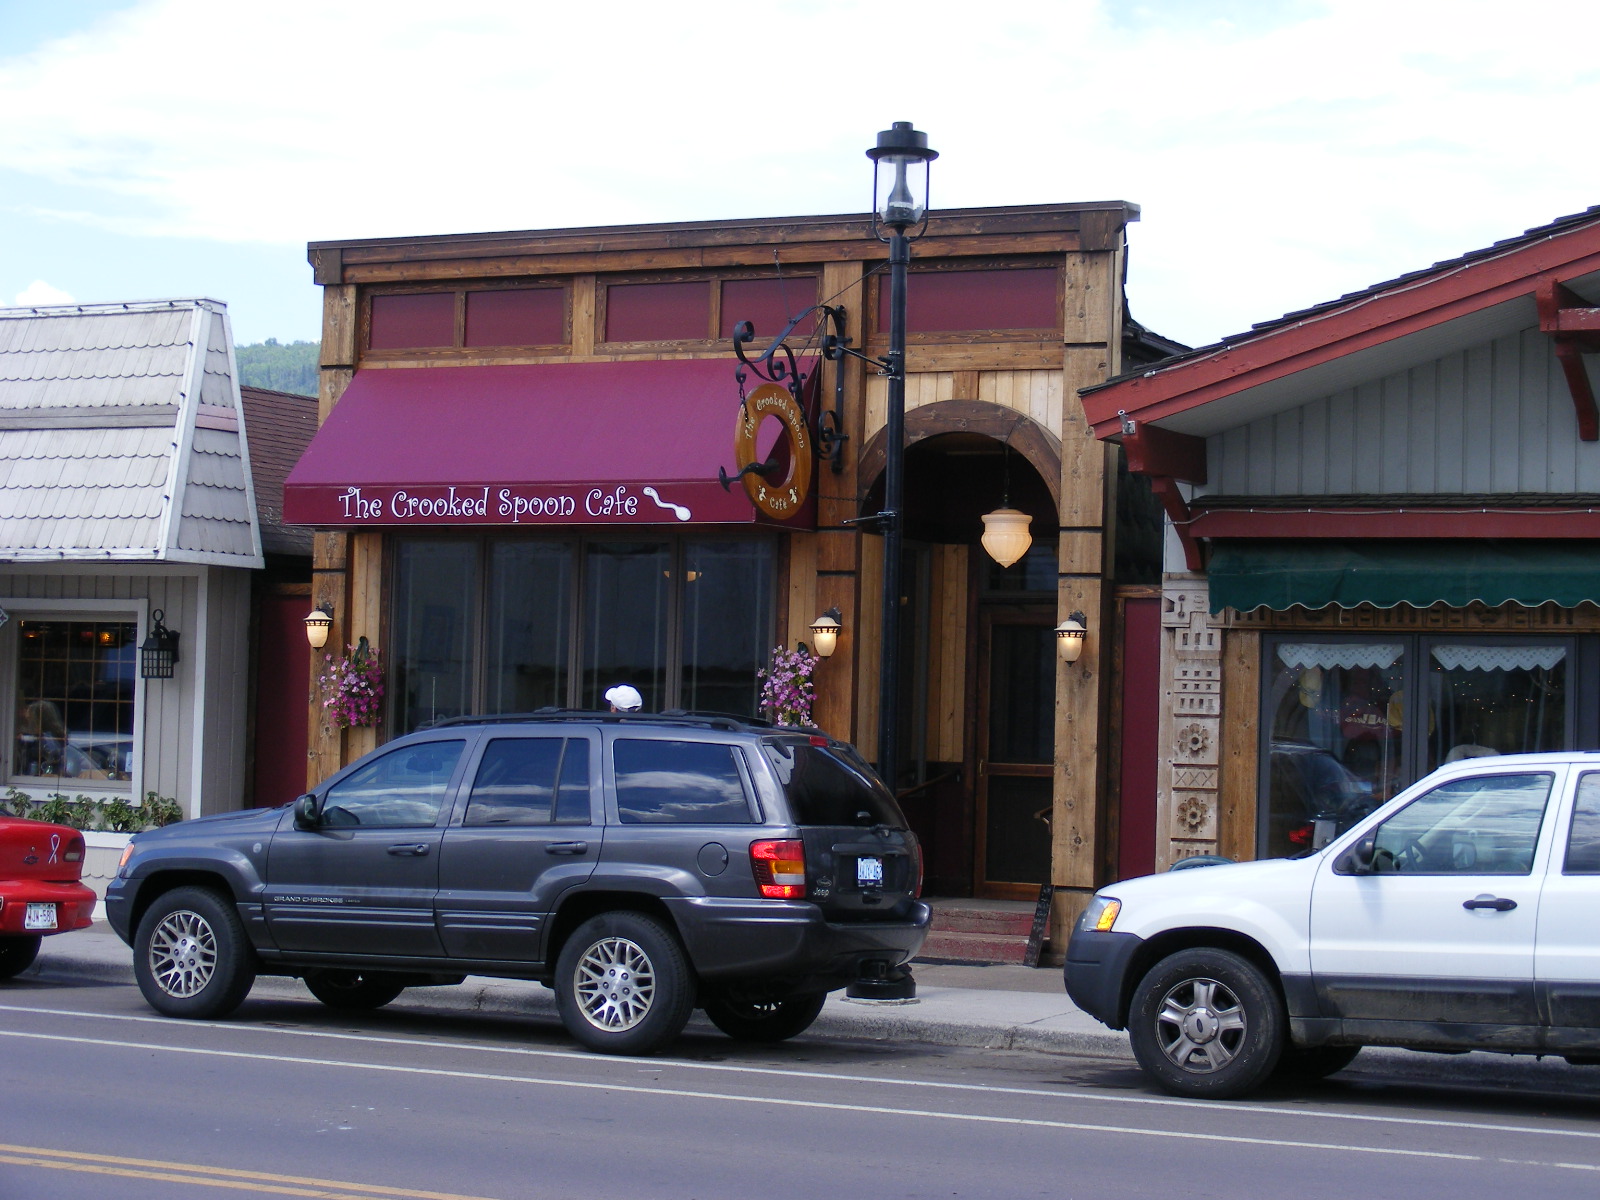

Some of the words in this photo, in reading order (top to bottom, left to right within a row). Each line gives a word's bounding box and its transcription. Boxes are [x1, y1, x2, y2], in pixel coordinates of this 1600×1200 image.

[338, 487, 382, 518] The
[391, 487, 490, 517] Crooked
[498, 488, 575, 522] Spoon
[584, 486, 639, 516] Cafe
[813, 888, 830, 898] Jeep
